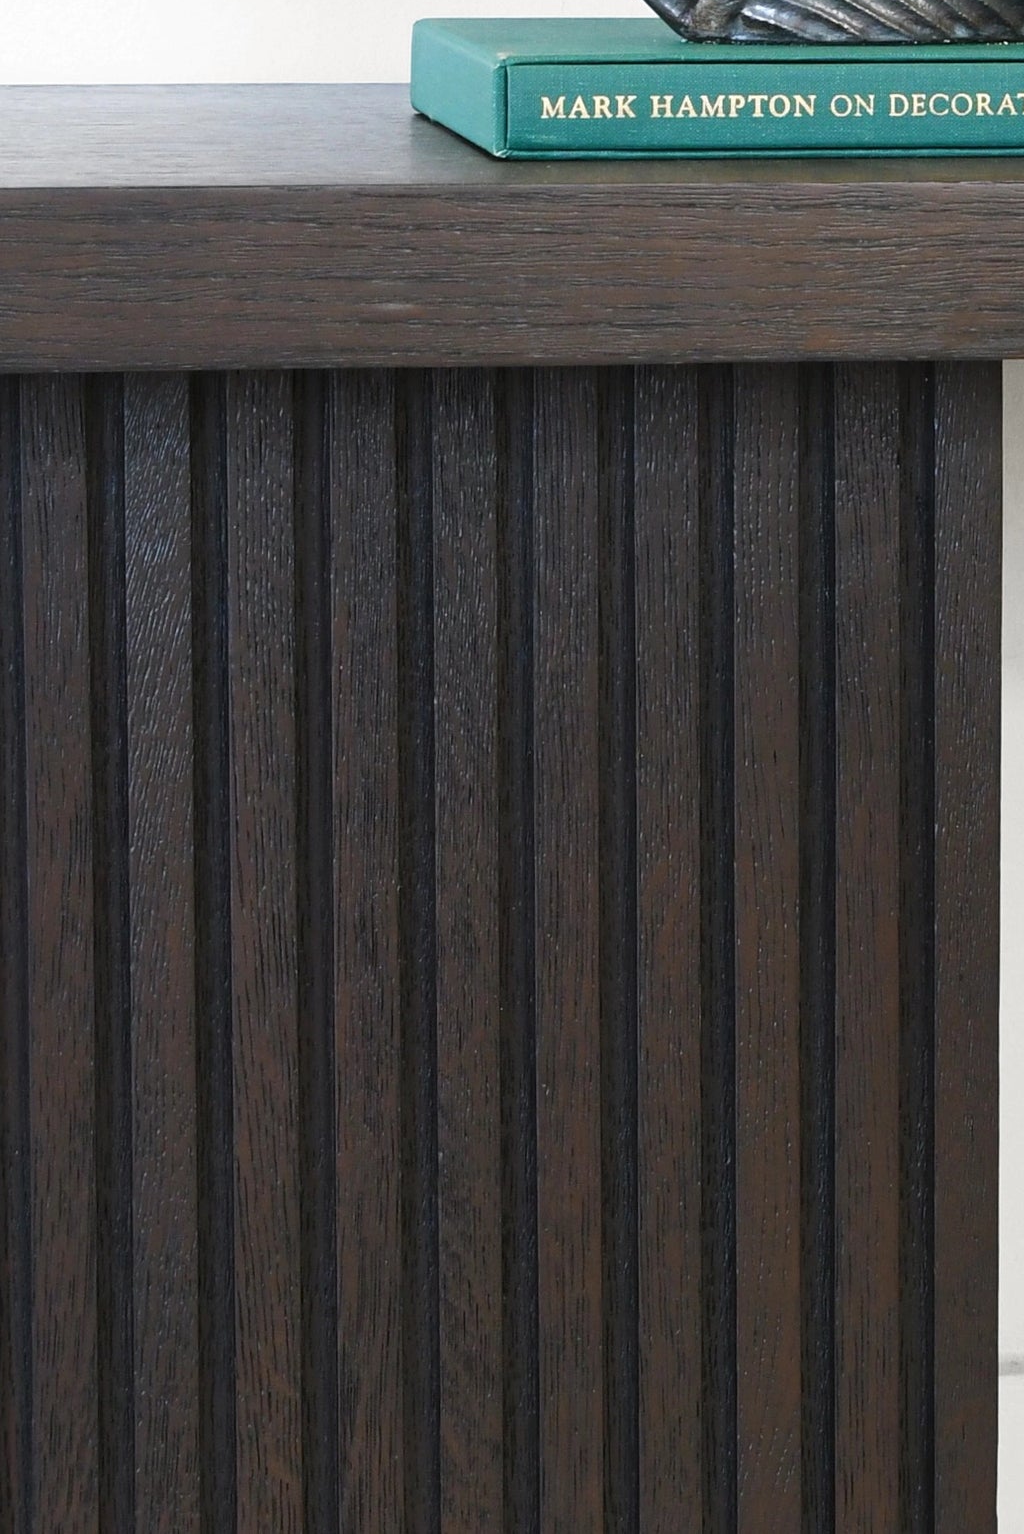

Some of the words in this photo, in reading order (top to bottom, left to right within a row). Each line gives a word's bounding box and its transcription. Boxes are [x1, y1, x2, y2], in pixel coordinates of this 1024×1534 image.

[540, 95, 637, 119] MARK
[650, 94, 816, 118] HAMPTON
[830, 93, 875, 117] ON
